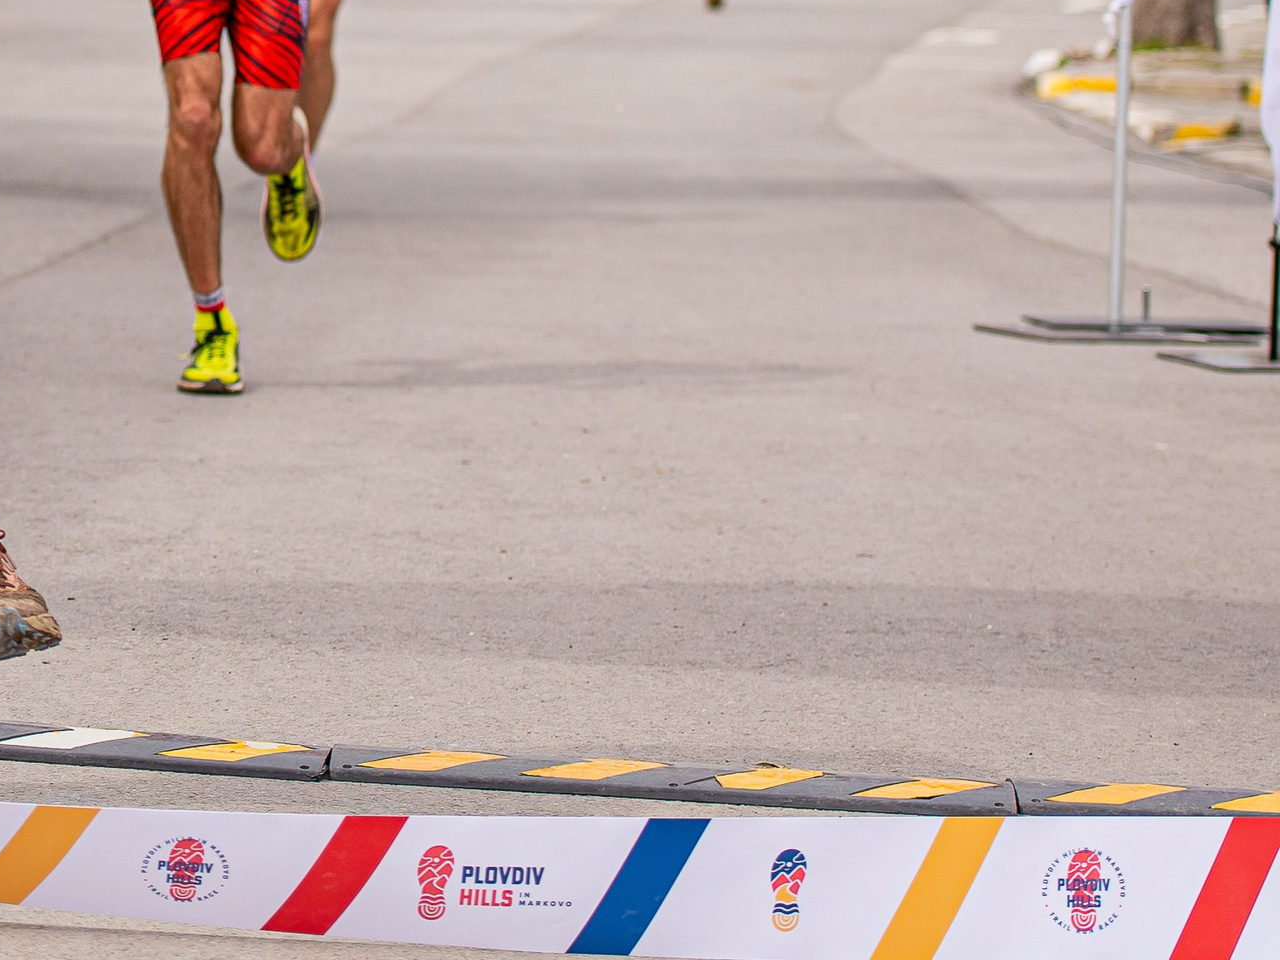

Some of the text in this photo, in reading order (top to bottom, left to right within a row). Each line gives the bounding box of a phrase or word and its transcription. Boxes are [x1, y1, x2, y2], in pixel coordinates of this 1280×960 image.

[157, 860, 214, 873] PLOVDIV
[166, 873, 202, 885] HILLS
[461, 865, 545, 885] PLOVDIV
[1057, 878, 1110, 891] PLOVDIV
[458, 889, 513, 907] HILLS
[1066, 894, 1102, 908] HILLS
